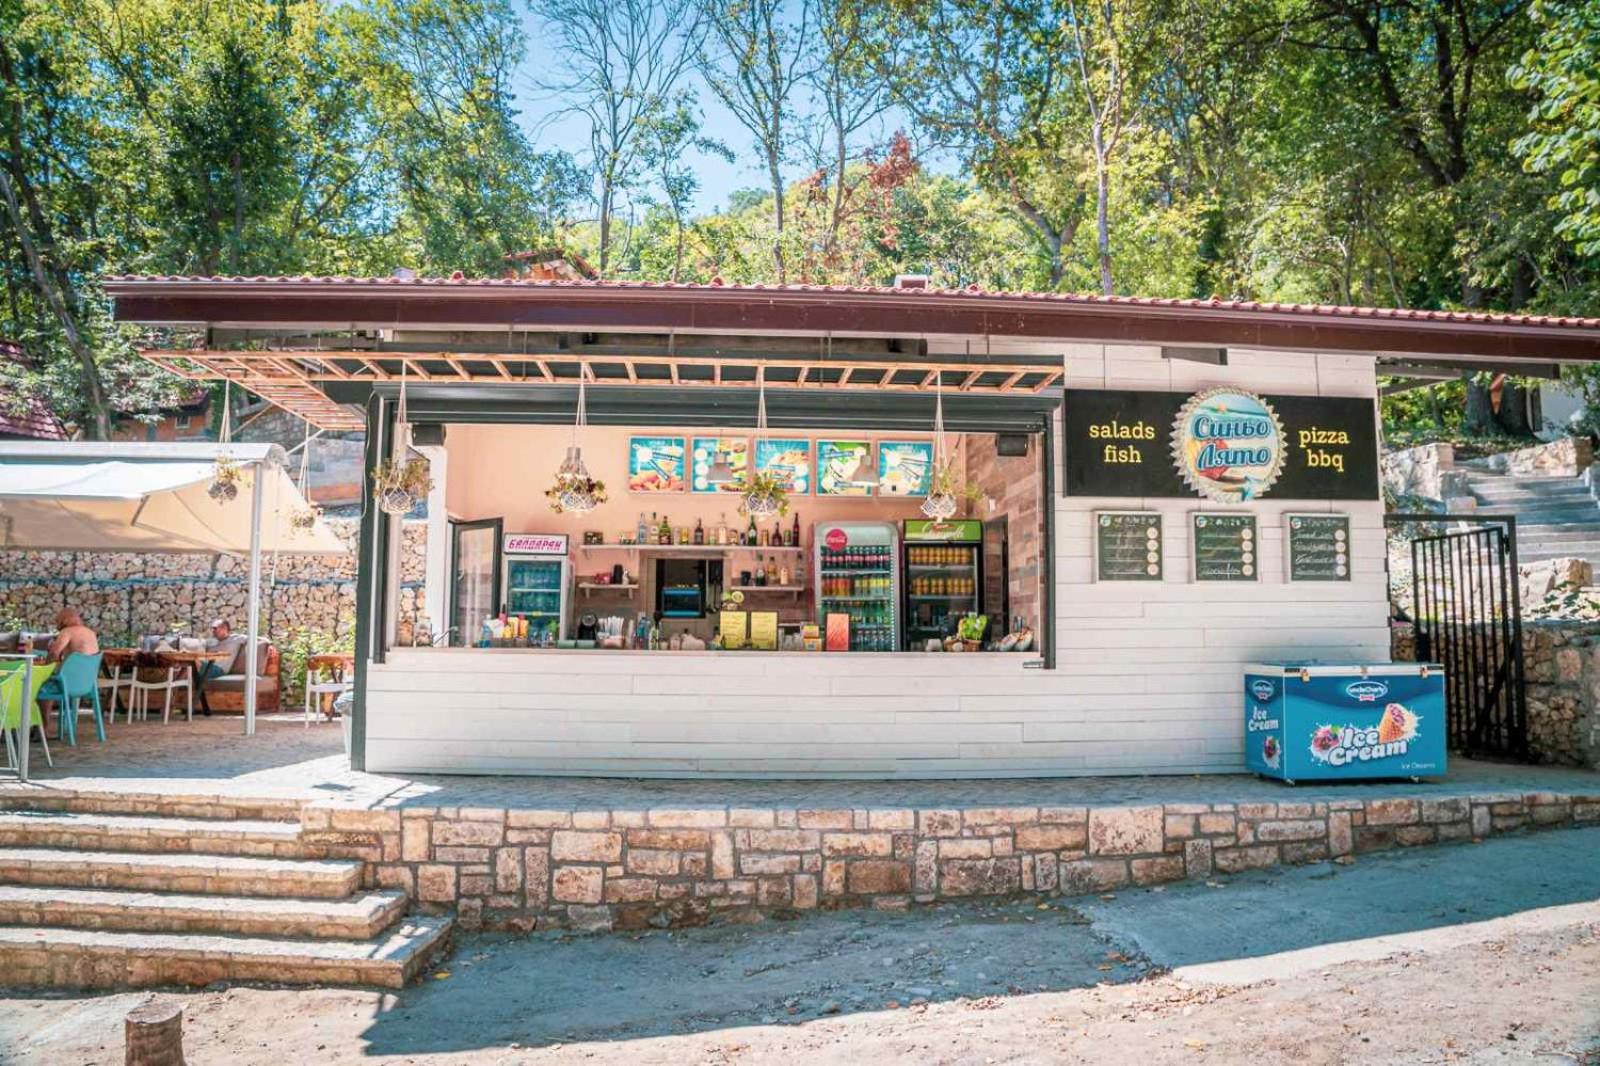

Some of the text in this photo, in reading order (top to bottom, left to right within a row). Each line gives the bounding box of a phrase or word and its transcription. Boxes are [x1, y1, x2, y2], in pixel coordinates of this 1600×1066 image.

[1089, 421, 1156, 439] salads
[1193, 415, 1271, 440] Синьо
[1299, 427, 1351, 448] pizza
[1103, 445, 1142, 463] fish
[1197, 445, 1272, 470] Лято
[1307, 448, 1345, 472] bbq
[1253, 705, 1267, 720] Ice
[1248, 719, 1279, 732] Cream
[1342, 727, 1380, 748] Ice
[1328, 740, 1408, 766] Cream
